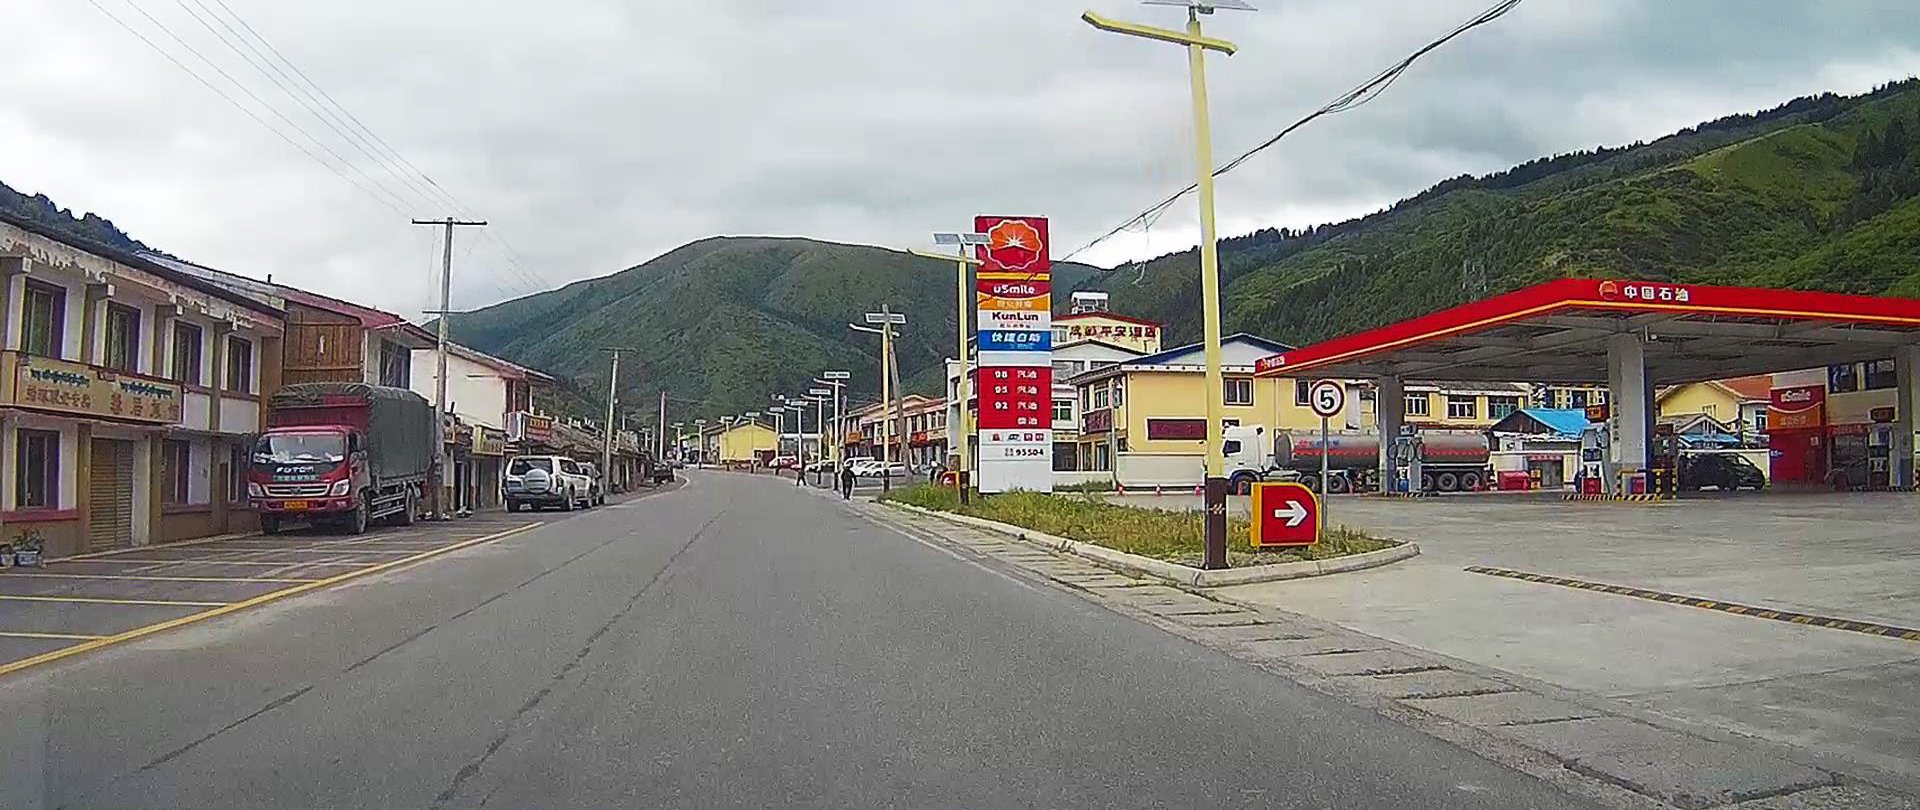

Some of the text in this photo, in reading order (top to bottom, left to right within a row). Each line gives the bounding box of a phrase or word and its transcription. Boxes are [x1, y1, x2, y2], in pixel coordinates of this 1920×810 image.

[993, 285, 1035, 294] uSmile
[1624, 285, 1689, 301] 中国石油
[992, 311, 1039, 321] KunLun
[995, 386, 1008, 394] 95
[1320, 390, 1335, 410] 5
[995, 402, 1008, 410] 92
